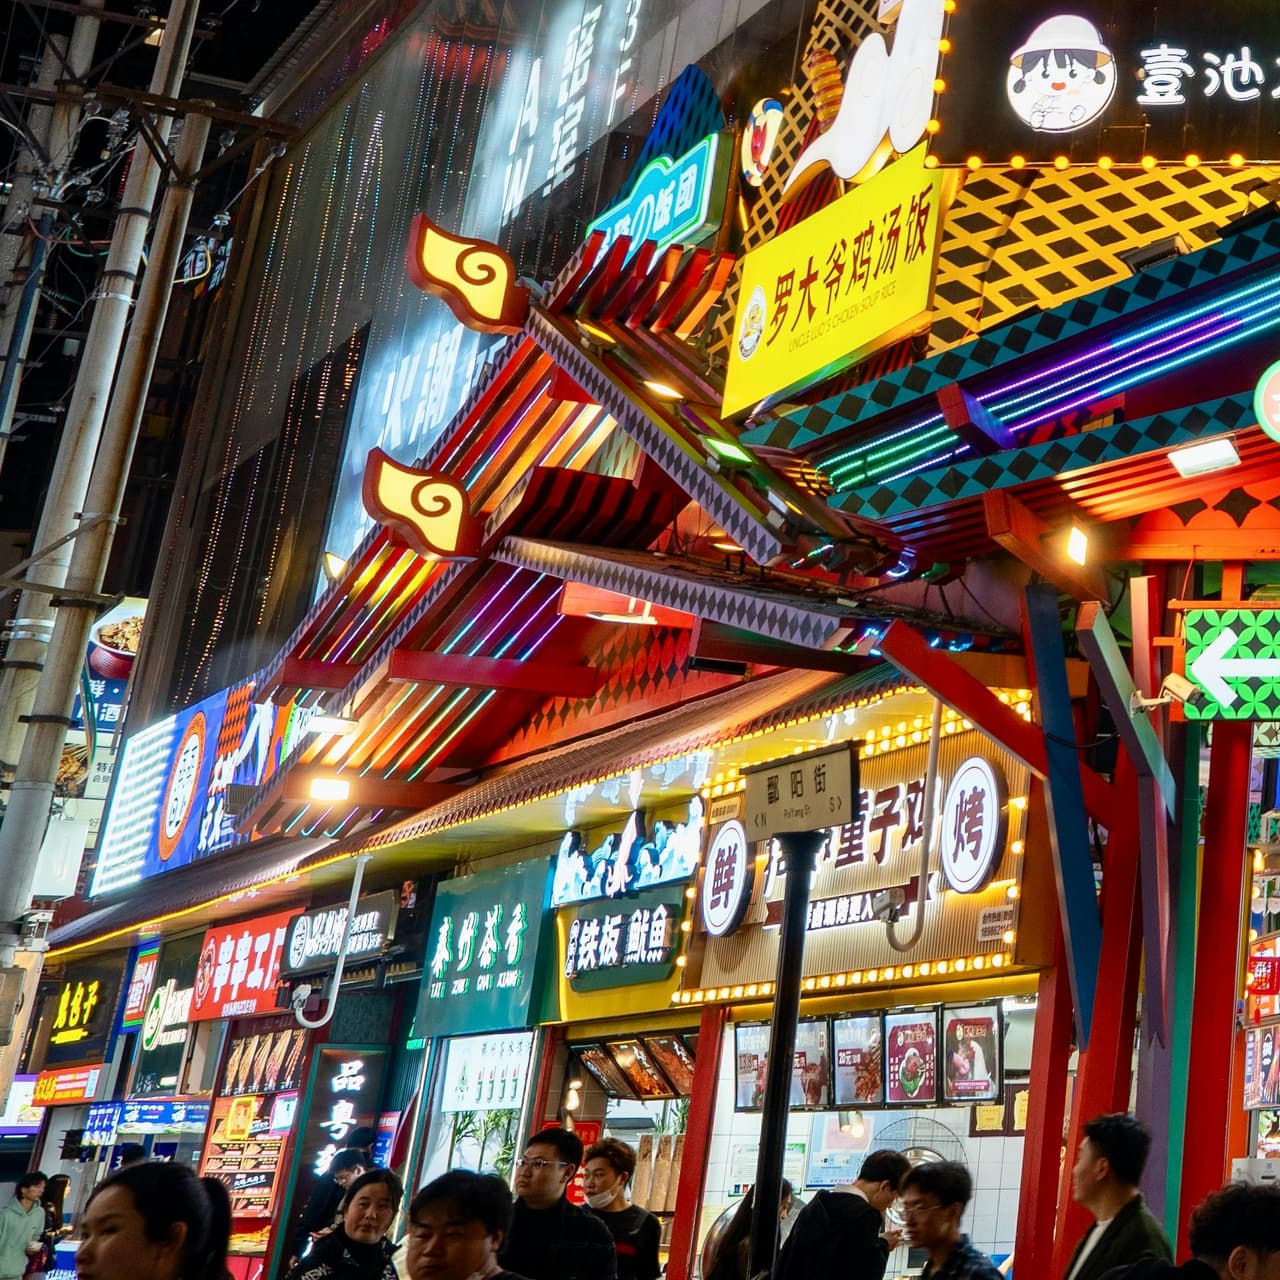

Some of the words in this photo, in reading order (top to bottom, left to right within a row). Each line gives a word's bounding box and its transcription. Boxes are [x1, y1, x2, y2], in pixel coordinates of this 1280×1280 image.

[766, 183, 934, 348] 罗大爷鸡汤饭
[767, 763, 826, 804] 鄱阳街
[764, 774, 937, 898] 童子鸡
[952, 785, 986, 864] 烤
[711, 843, 738, 911] 鲜
[577, 904, 669, 971] 铁板鱿鱼
